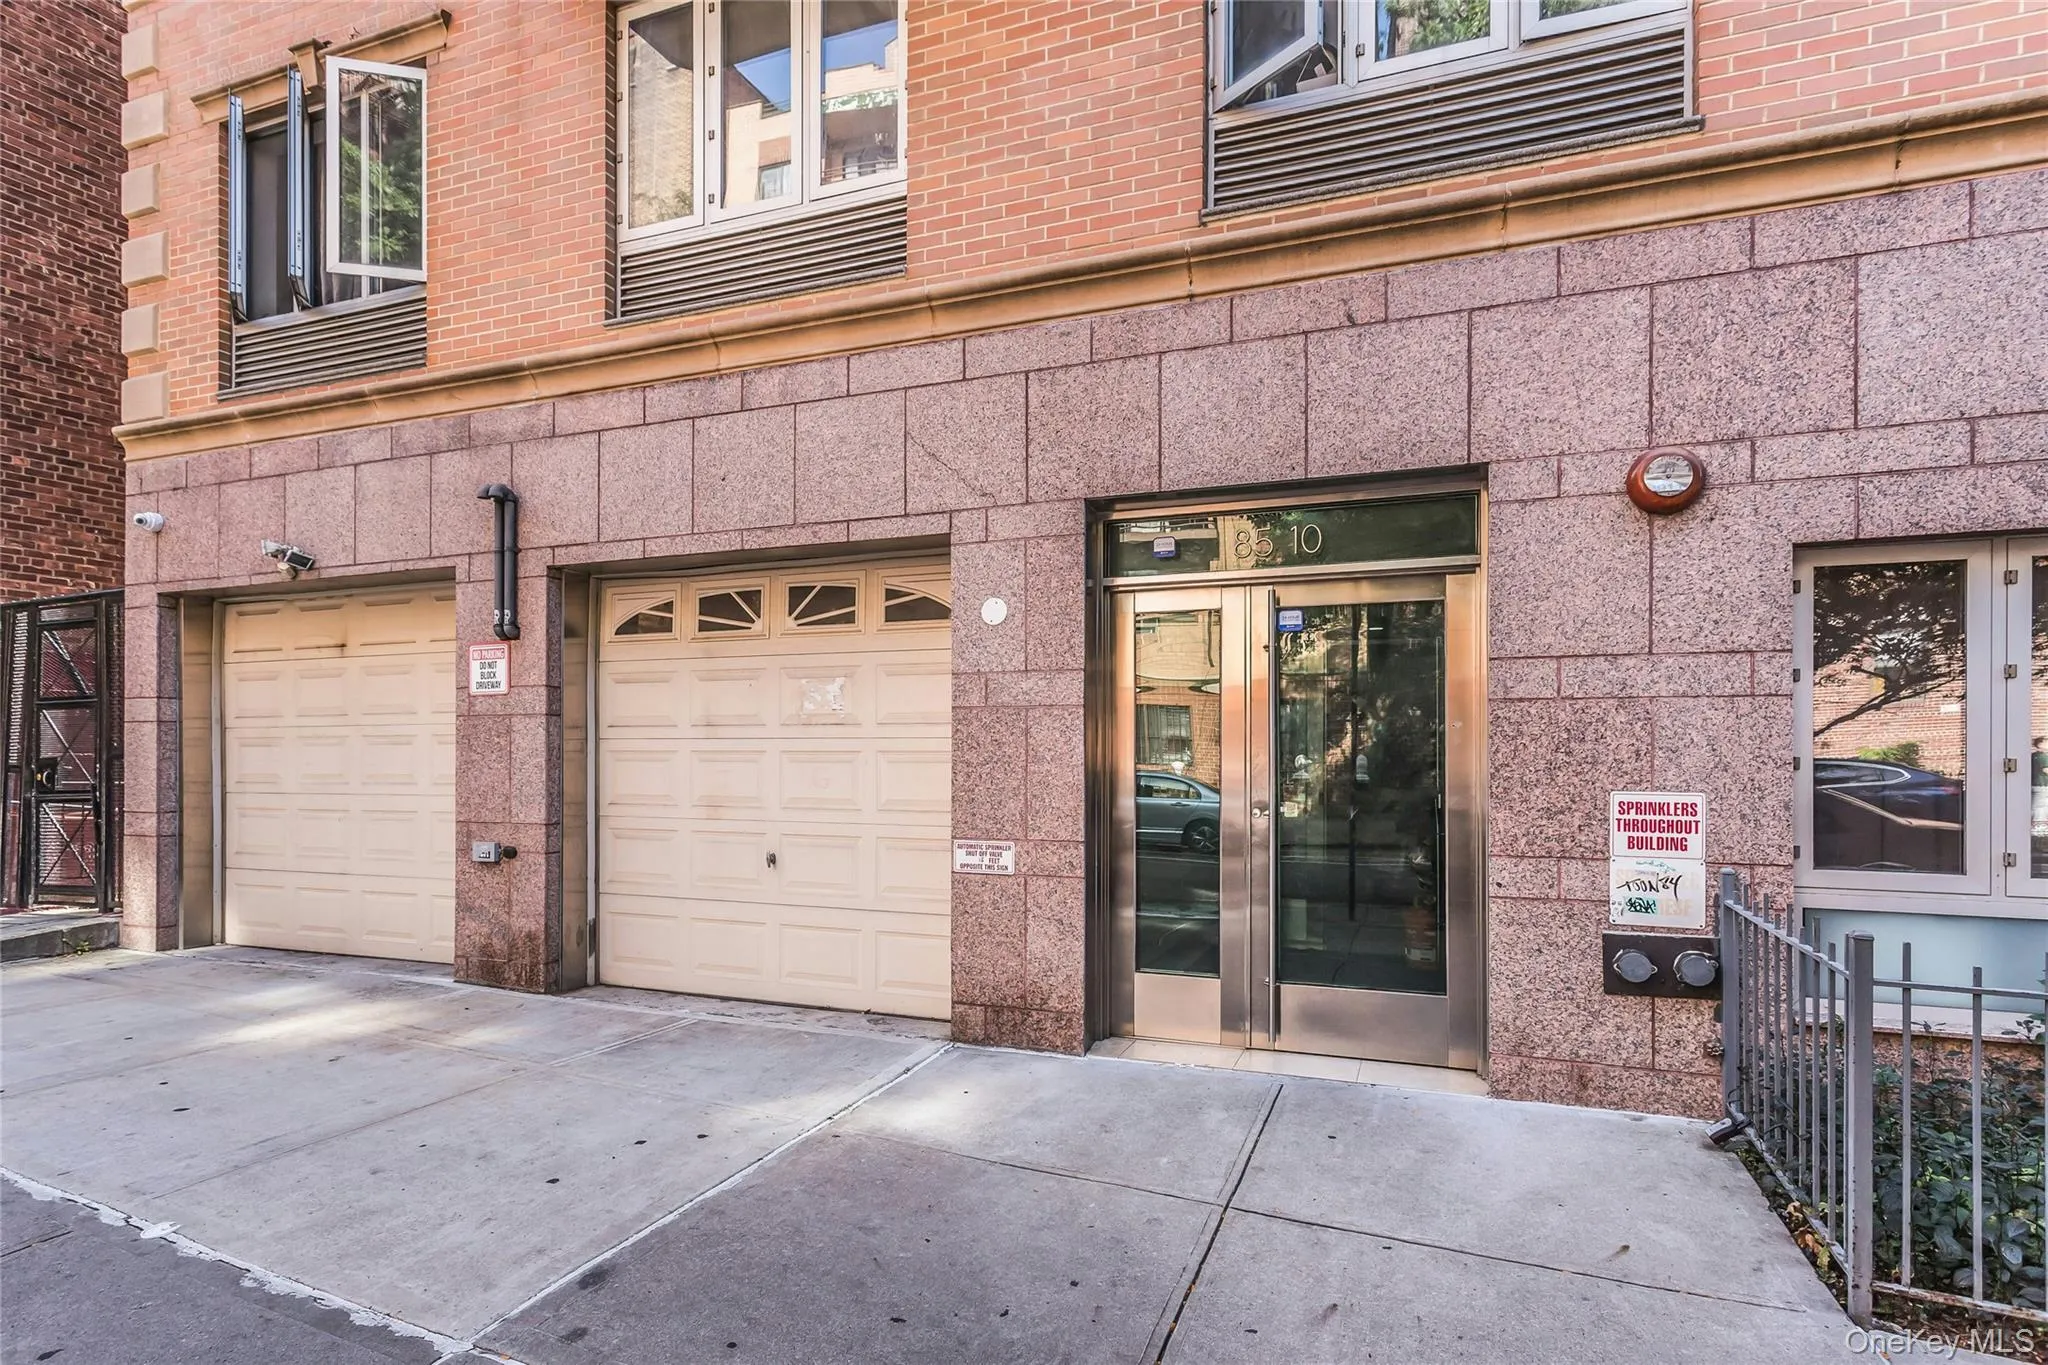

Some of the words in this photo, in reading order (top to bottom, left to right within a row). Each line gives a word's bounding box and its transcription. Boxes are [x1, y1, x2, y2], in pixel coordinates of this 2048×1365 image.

[1234, 527, 1273, 558] 85
[1290, 523, 1322, 554] 10
[480, 662, 486, 670] DO
[487, 661, 497, 670] NOT
[480, 671, 497, 680] BLOCK
[476, 681, 502, 690] DRIVEWAY
[1617, 800, 1698, 818] SPRINKLERS
[1615, 817, 1701, 836] THROUGHOUT
[1627, 835, 1688, 852] BUILDING
